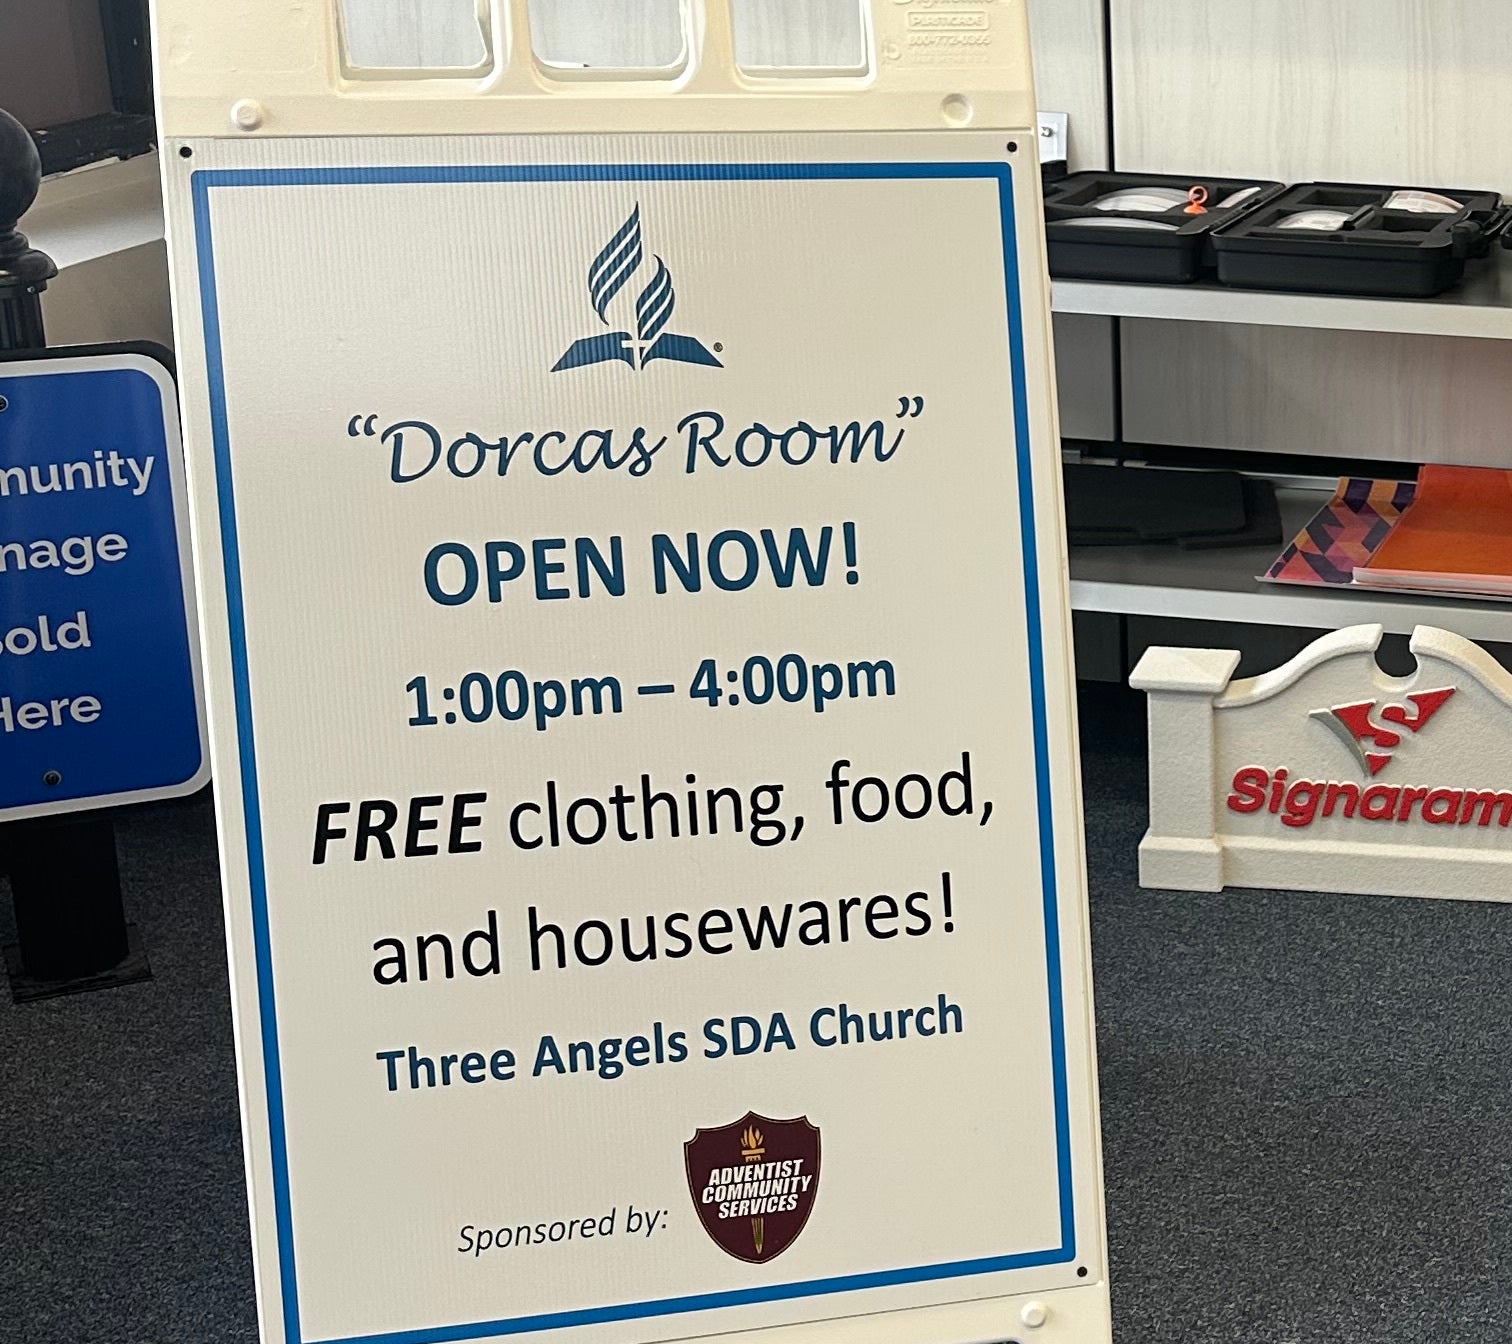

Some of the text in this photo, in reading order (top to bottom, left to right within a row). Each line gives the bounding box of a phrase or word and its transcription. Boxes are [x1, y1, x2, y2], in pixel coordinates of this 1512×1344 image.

[347, 395, 924, 484] “Dorcas Room”
[423, 521, 859, 607] OPEN NOW!
[0, 611, 92, 655] old
[405, 669, 623, 732] 1:00pm
[689, 653, 896, 713] 4:00pm
[312, 751, 993, 865] FREE clothing, food,
[373, 871, 954, 985] and housewares!
[375, 993, 963, 1092] Three Angels SDA Church
[701, 1175, 811, 1206] COMMUNITY
[708, 1158, 804, 1188] ADVENTIST
[718, 1195, 798, 1218] SERVICES
[457, 1205, 668, 1253] Sponsored by:
